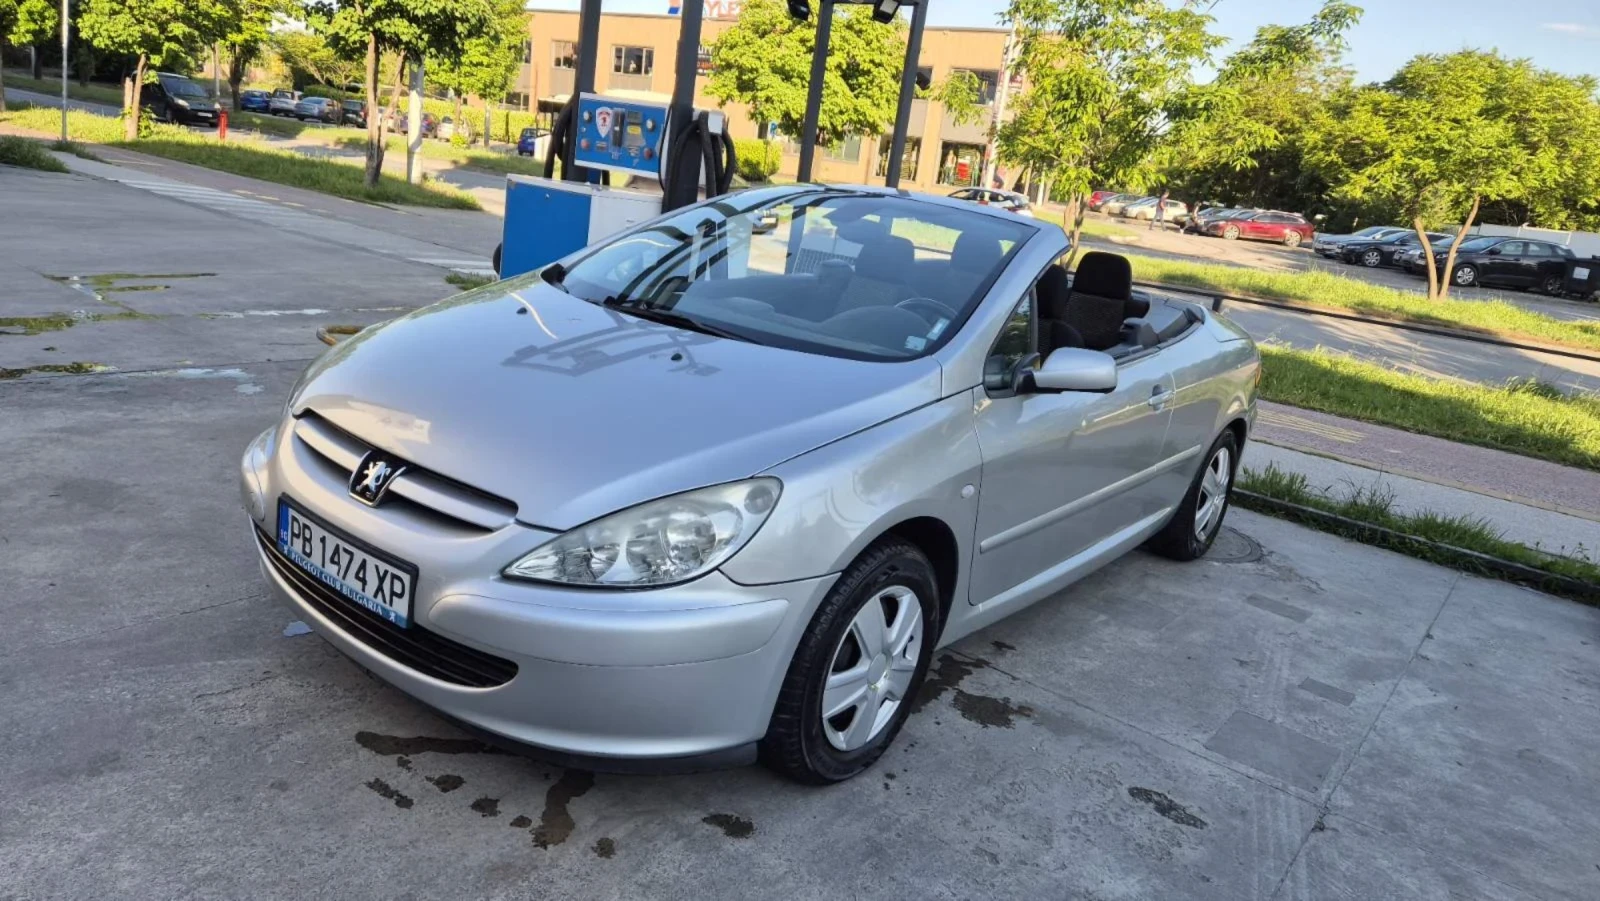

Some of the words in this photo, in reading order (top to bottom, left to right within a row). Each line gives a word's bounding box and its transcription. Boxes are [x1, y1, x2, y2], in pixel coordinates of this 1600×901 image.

[291, 515, 312, 558] PB
[320, 536, 367, 592] 1474
[373, 565, 405, 607] XP
[291, 552, 321, 578] PEUGEOT
[322, 573, 341, 591] CLUB
[342, 586, 383, 615] BULGARIA
